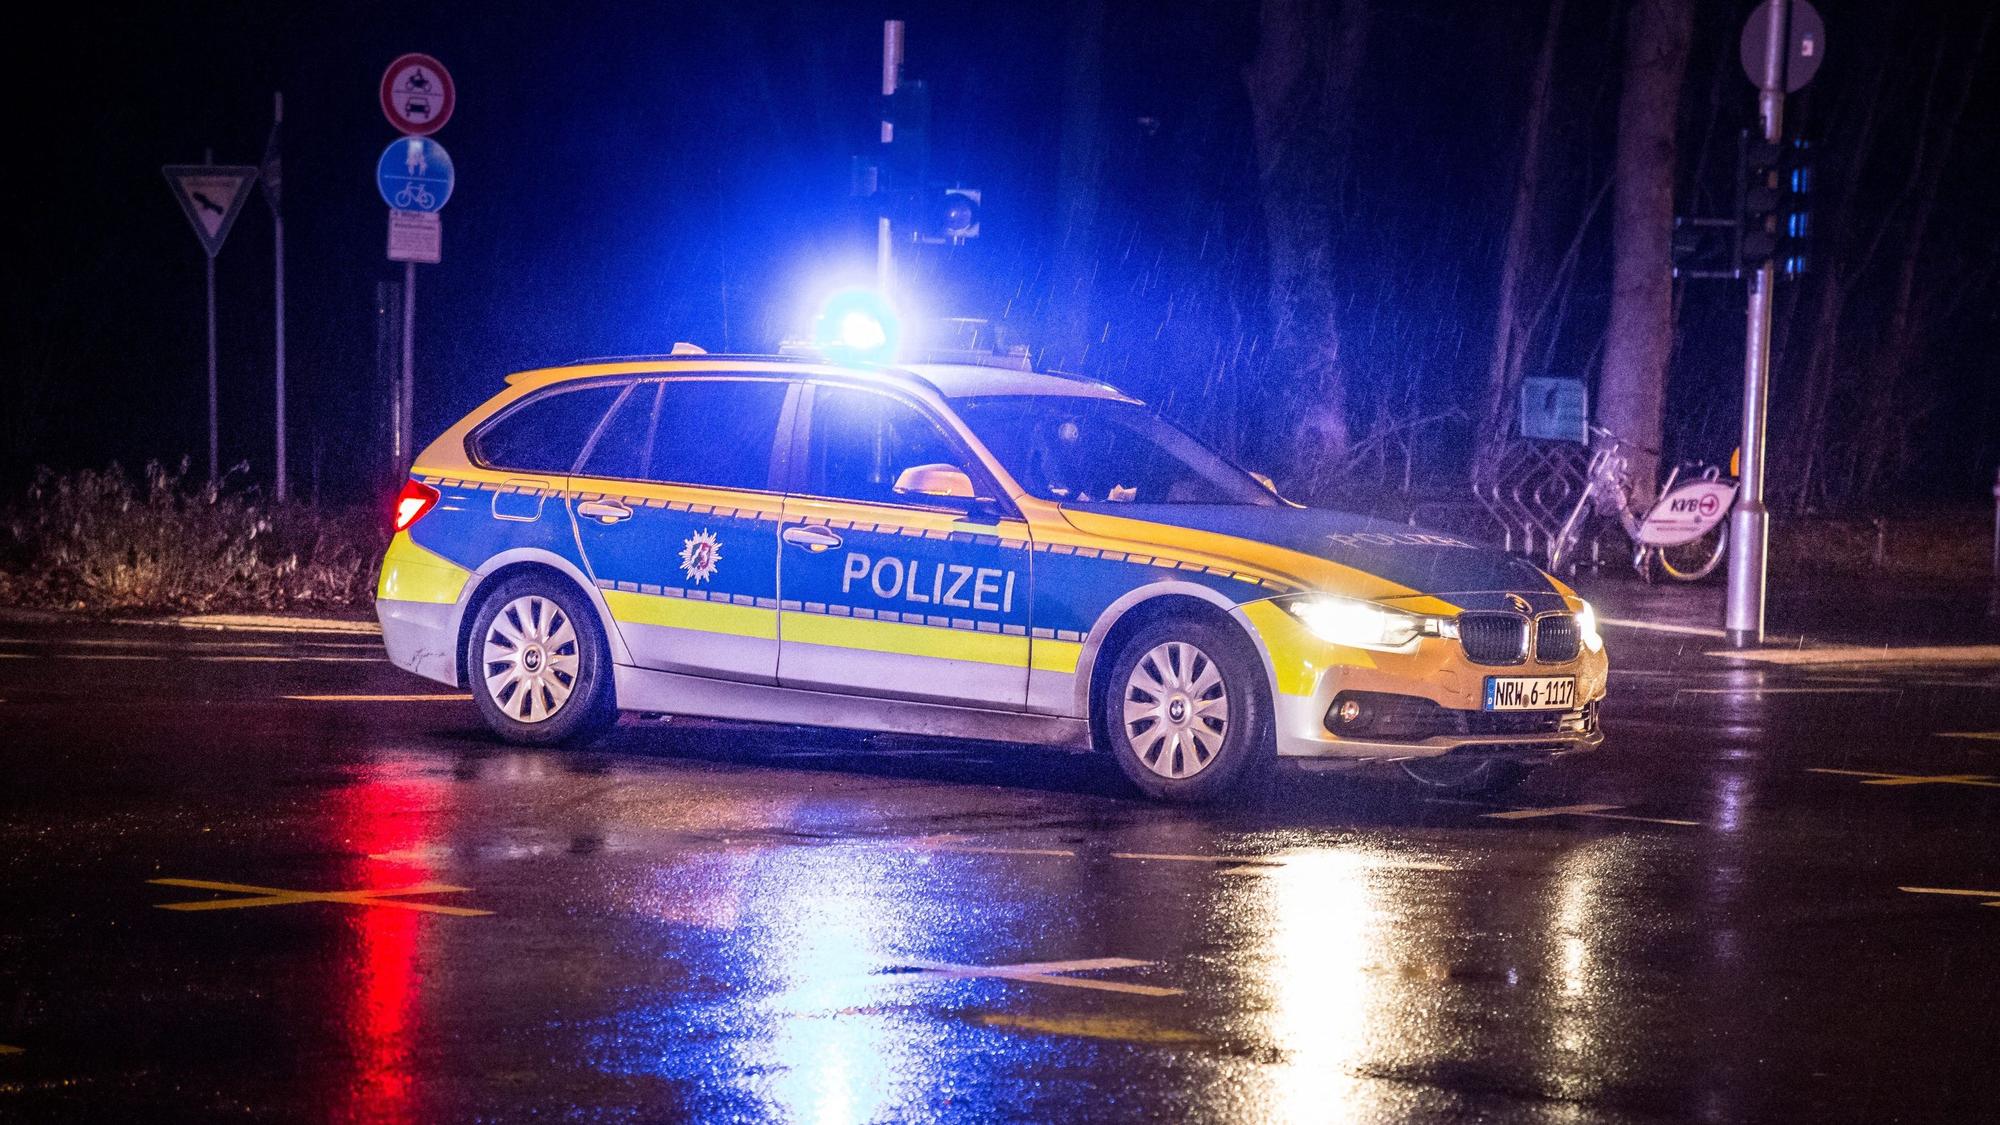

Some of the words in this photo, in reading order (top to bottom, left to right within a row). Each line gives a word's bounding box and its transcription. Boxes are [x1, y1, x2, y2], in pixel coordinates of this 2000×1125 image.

[1671, 499, 1699, 512] KVB
[842, 552, 1015, 613] POLIZEI
[1496, 681, 1523, 706] NRW
[1530, 681, 1573, 706] 6-1117
